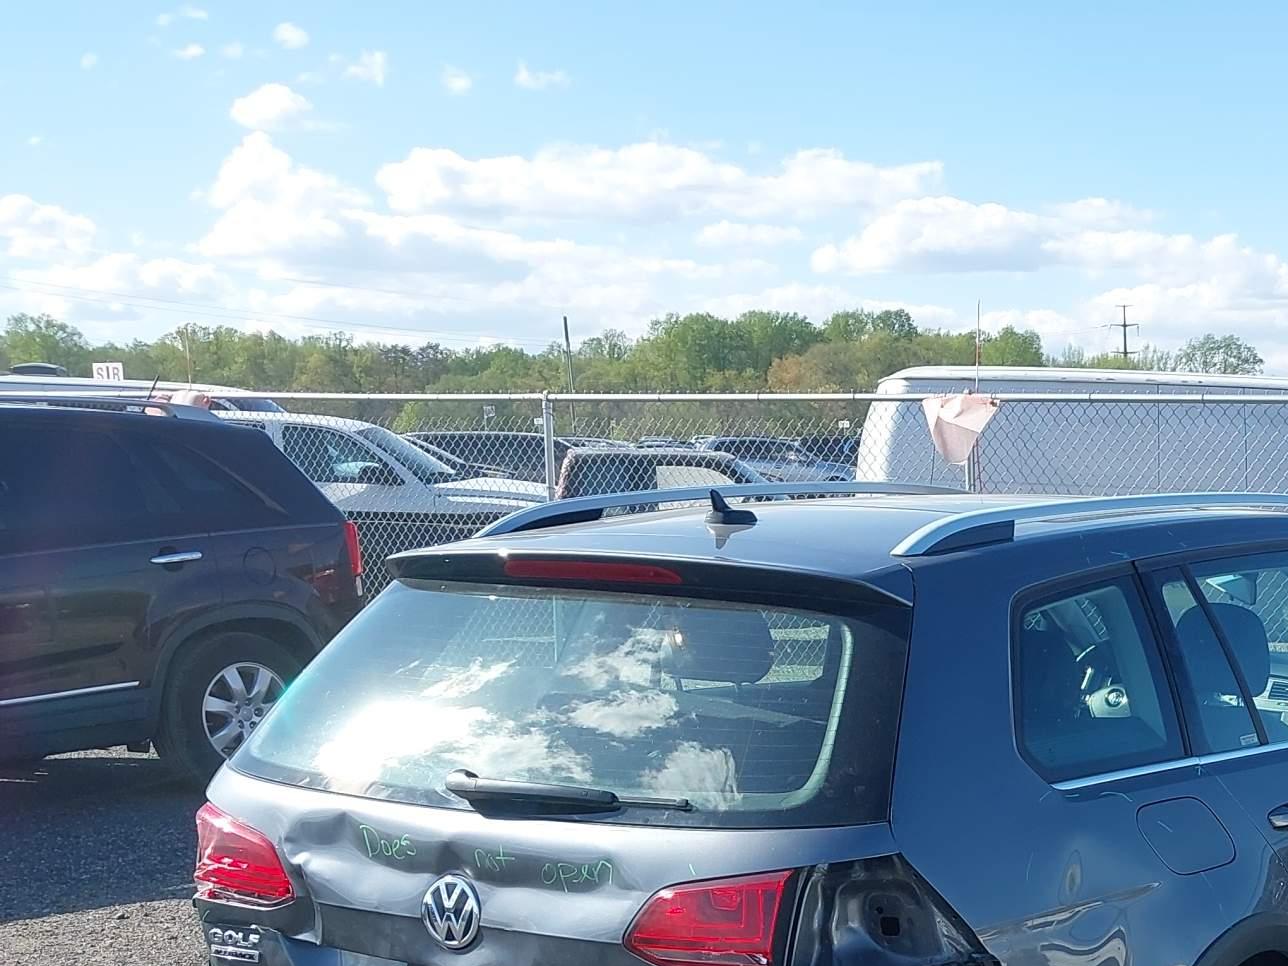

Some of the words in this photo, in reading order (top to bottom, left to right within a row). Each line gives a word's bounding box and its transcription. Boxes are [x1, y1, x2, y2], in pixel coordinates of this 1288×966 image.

[360, 825, 417, 859] Does
[474, 845, 515, 872] not
[541, 859, 613, 893] open
[209, 928, 260, 948] GOLF
